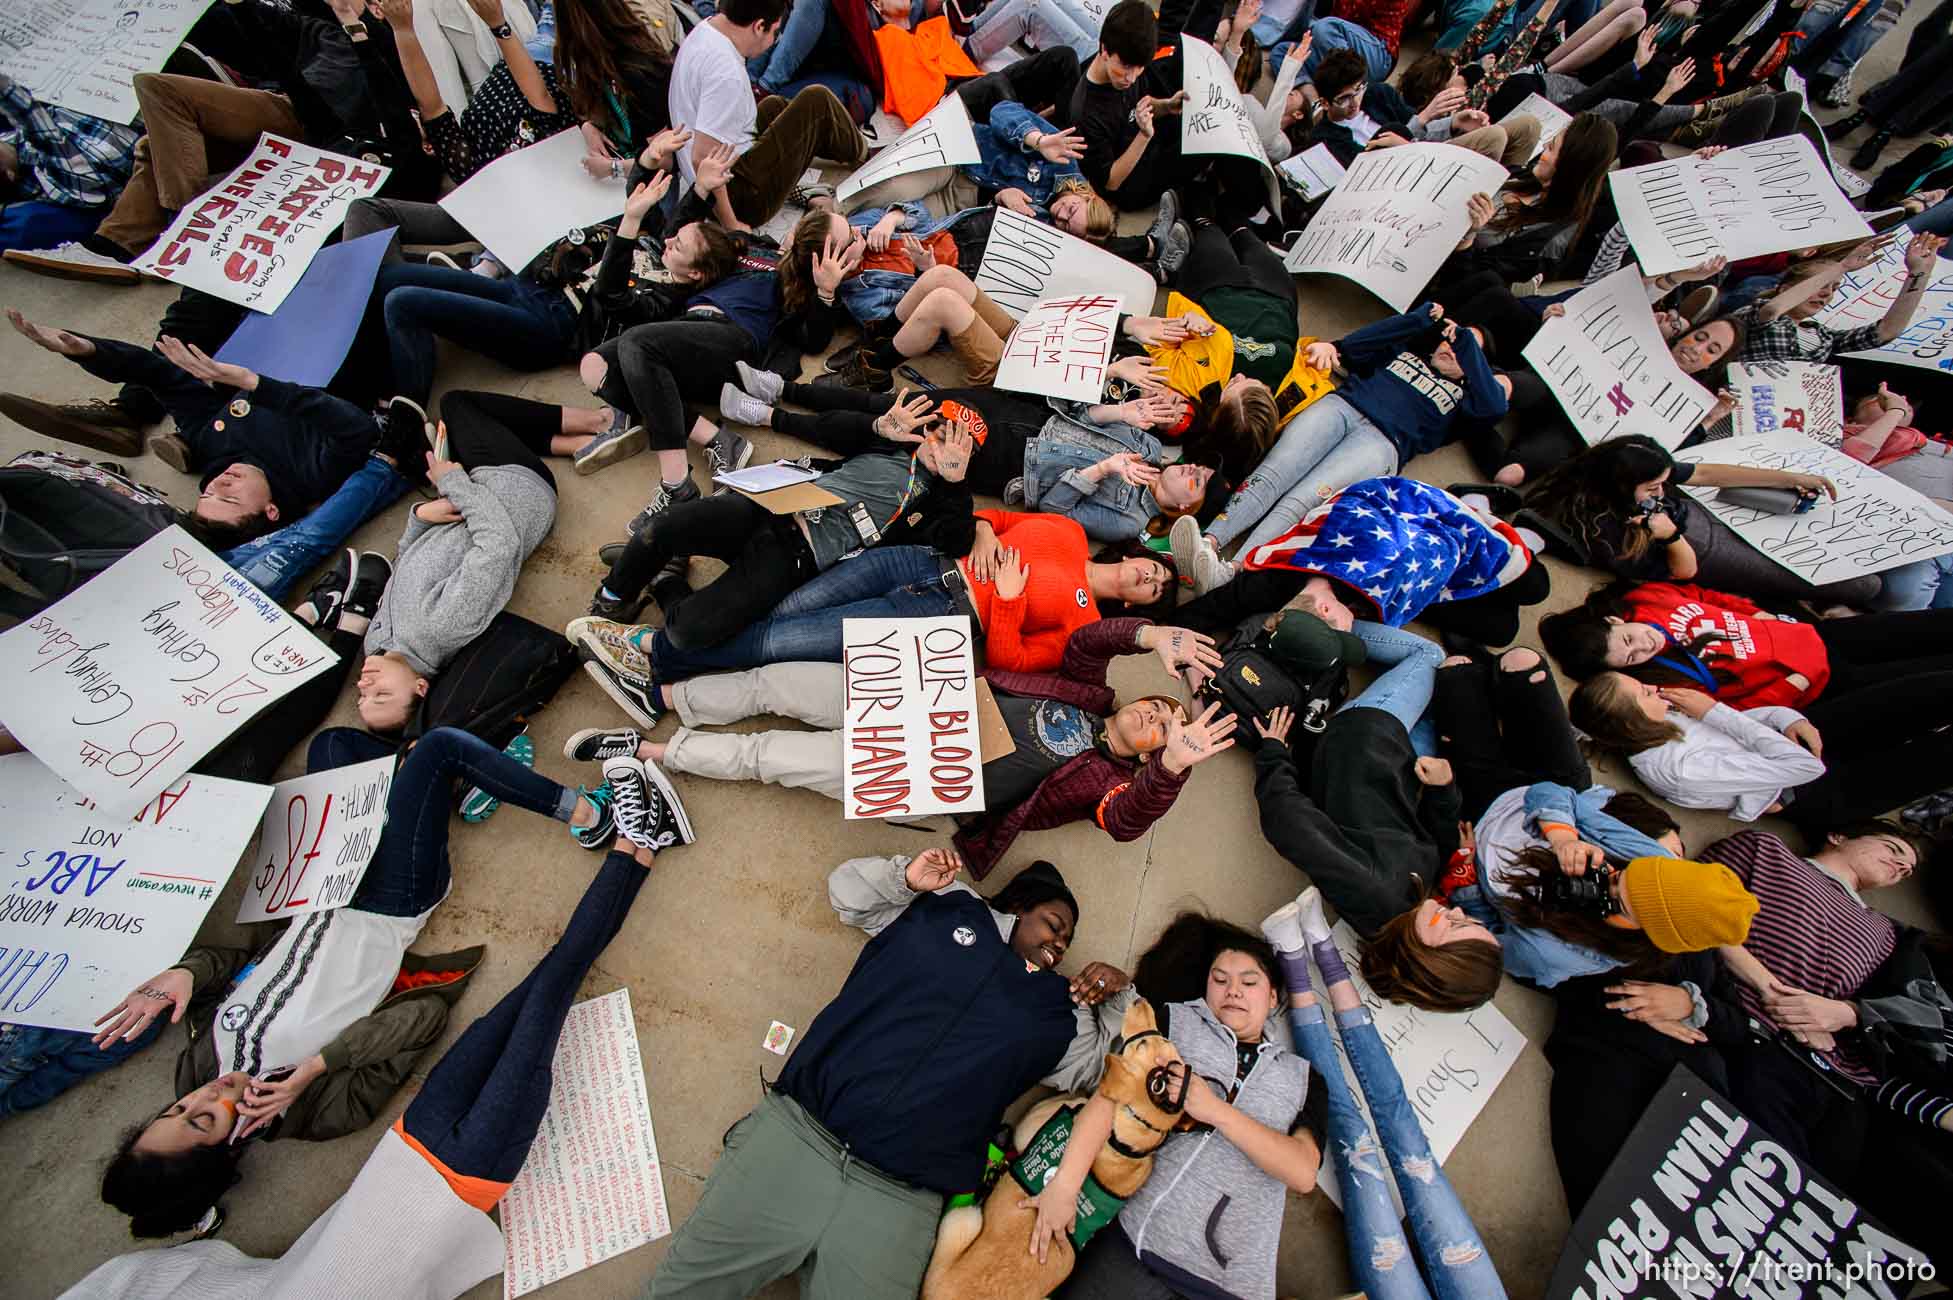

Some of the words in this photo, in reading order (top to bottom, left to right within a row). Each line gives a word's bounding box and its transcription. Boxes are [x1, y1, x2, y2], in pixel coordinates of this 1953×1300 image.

[1187, 112, 1221, 137] ARE
[347, 166, 381, 189] I
[1342, 152, 1480, 209] WELCOME
[146, 138, 292, 278] FUNERALS!
[224, 157, 346, 284] PARTIES
[284, 223, 314, 245] be
[1040, 295, 1118, 385] #VOTE
[1042, 314, 1069, 364] THEM
[1575, 293, 1648, 381] DEATH
[1648, 377, 1704, 434] LIFE
[1761, 522, 1838, 578] YOUR
[163, 547, 240, 629] Weapons
[222, 571, 282, 625] #NeverAgain
[29, 615, 81, 673] Laws
[141, 600, 221, 682] Century
[280, 645, 309, 667] NRA
[924, 627, 967, 707] OUR
[64, 642, 134, 726] Century
[182, 673, 268, 714] 21st
[847, 629, 904, 723] YOUR
[80, 722, 184, 788] 18th
[851, 724, 911, 817] HANDS
[928, 710, 974, 803] BLOOD
[71, 825, 122, 849] NOT
[336, 826, 373, 867] YOUR
[315, 872, 358, 907] KNOW
[64, 904, 145, 935] should
[1026, 1158, 1050, 1182] Dogs
[1652, 1099, 1748, 1212] THAN
[1695, 1140, 1801, 1267] GUNS
